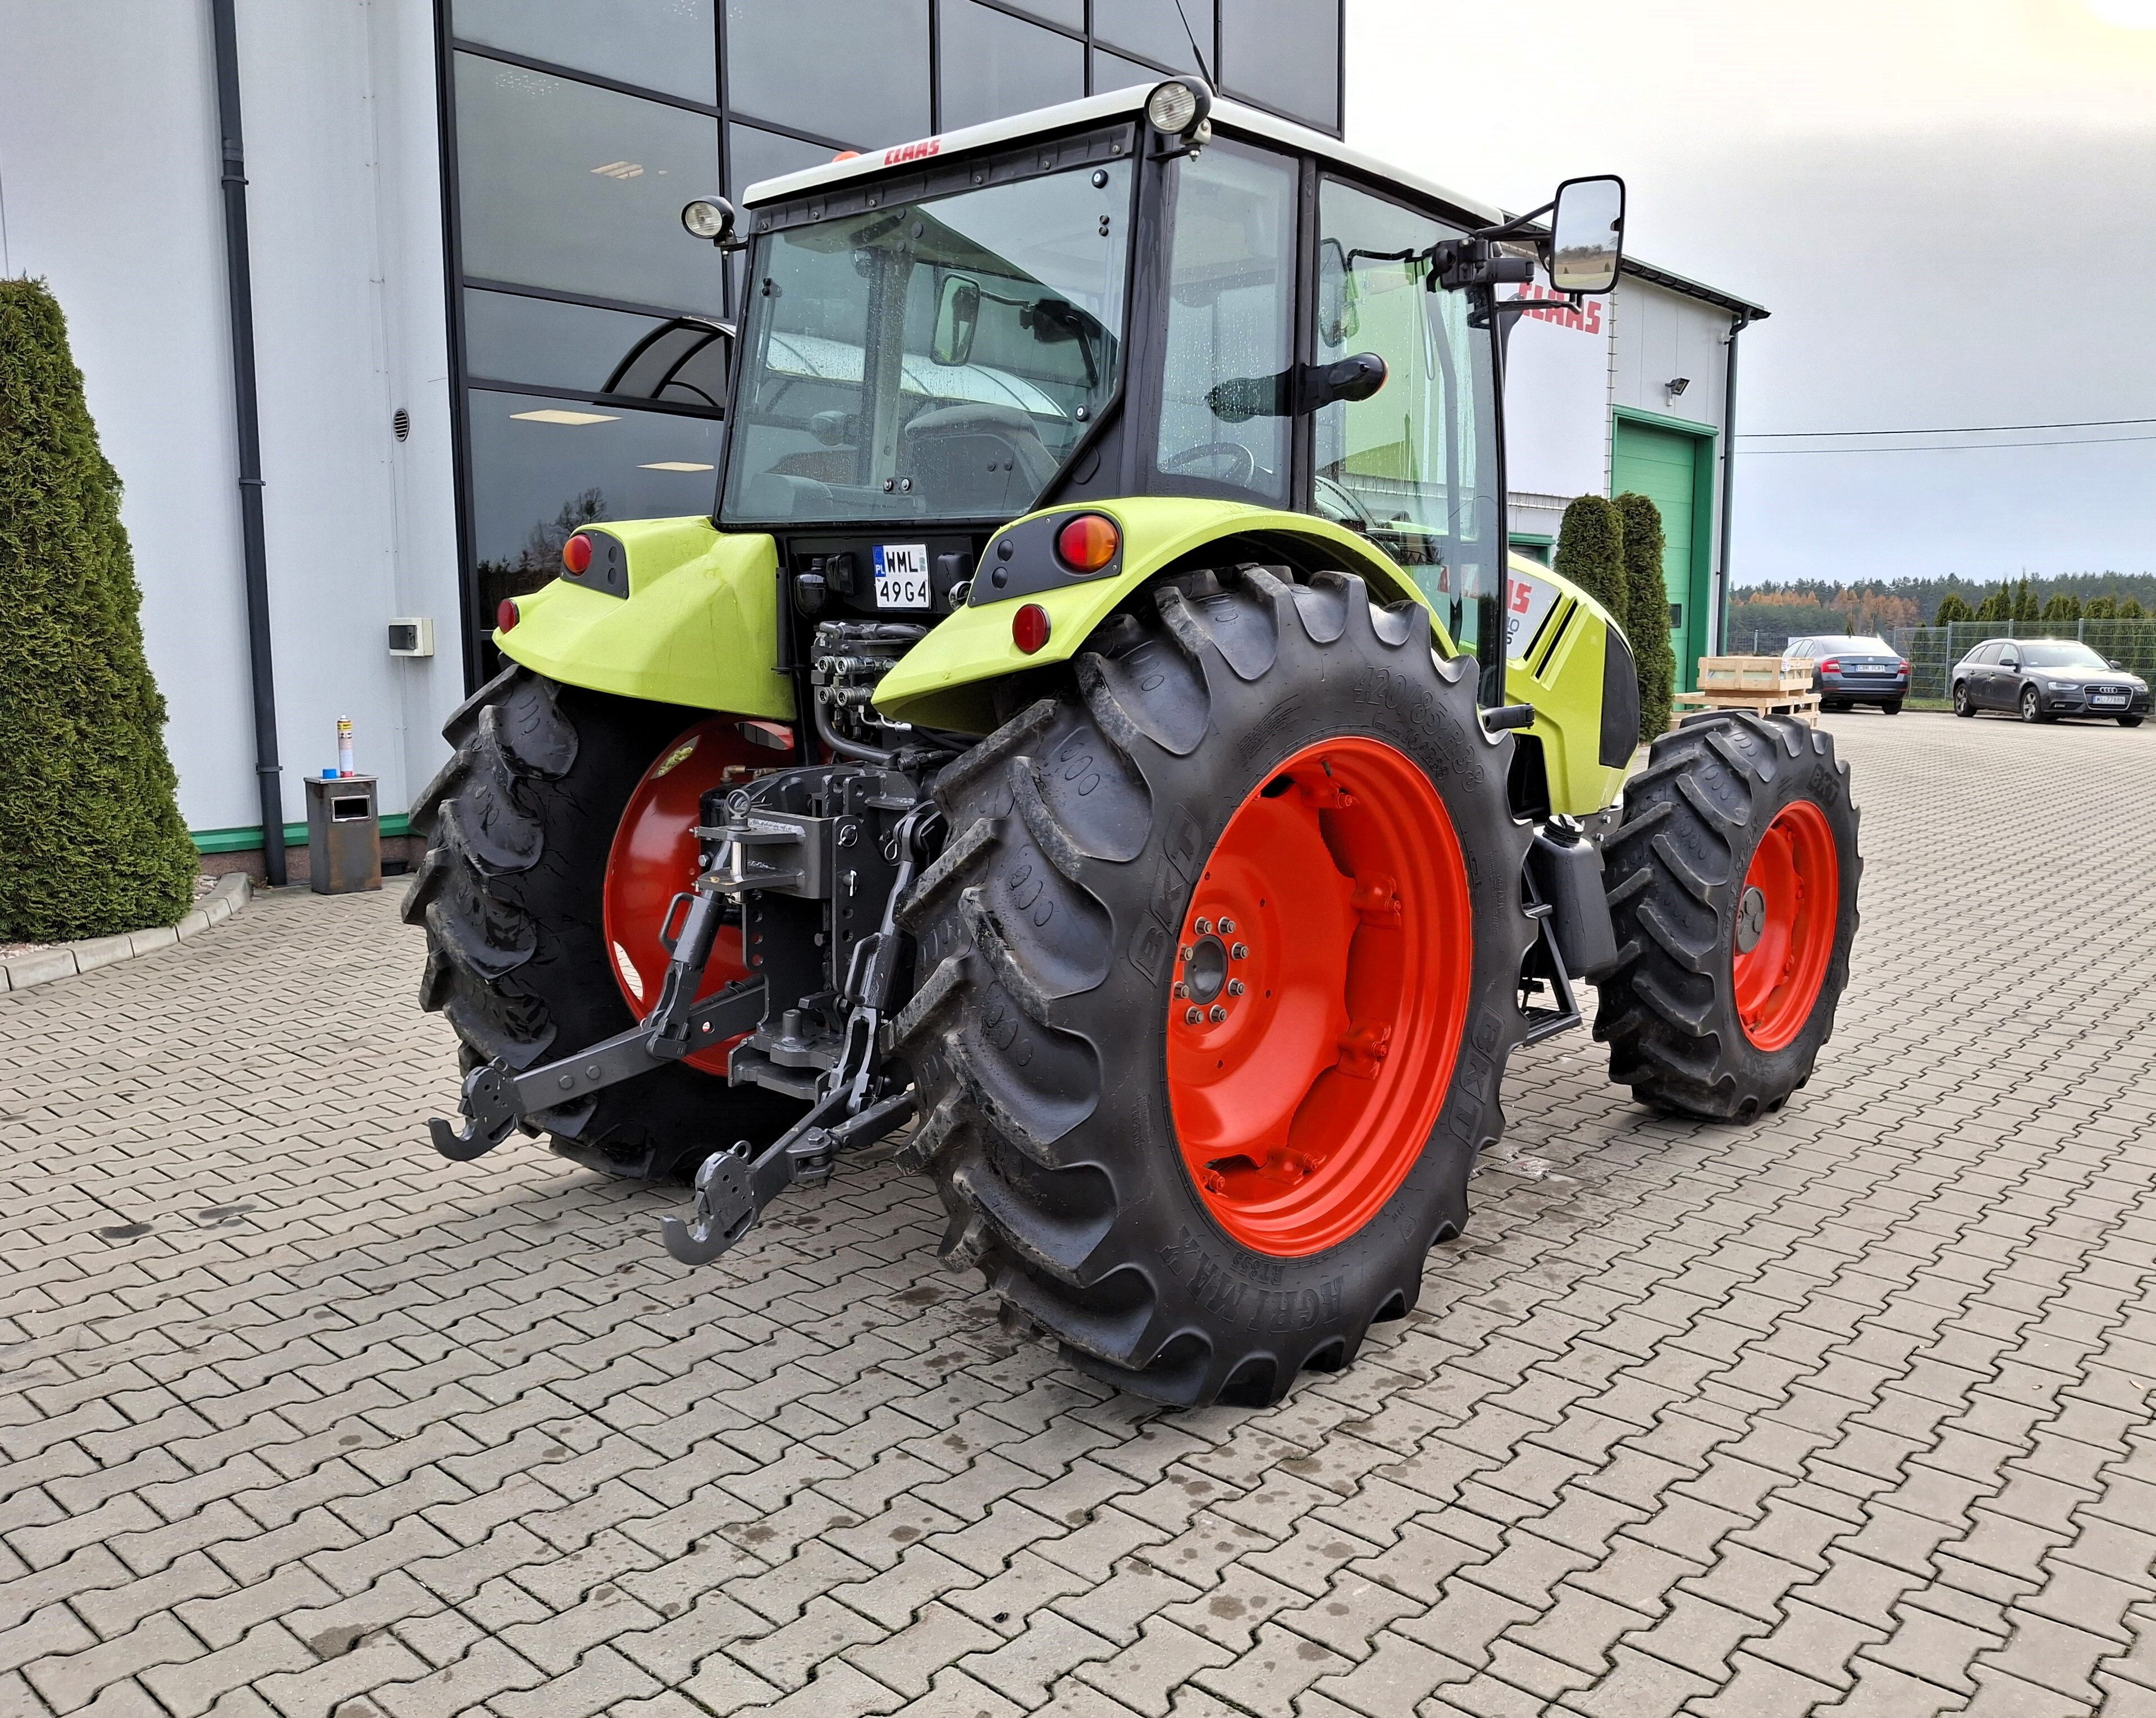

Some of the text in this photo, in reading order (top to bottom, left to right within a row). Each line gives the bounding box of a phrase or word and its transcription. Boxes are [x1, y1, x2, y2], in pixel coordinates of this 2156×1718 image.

[884, 139, 940, 166] CLAAS
[875, 564, 885, 574] PL
[886, 551, 919, 573] WML
[880, 581, 926, 602] 49G4
[1354, 665, 1484, 792] 420/85R38
[1131, 807, 1200, 984] BKT
[1159, 1224, 1344, 1333] AGRIMAX
